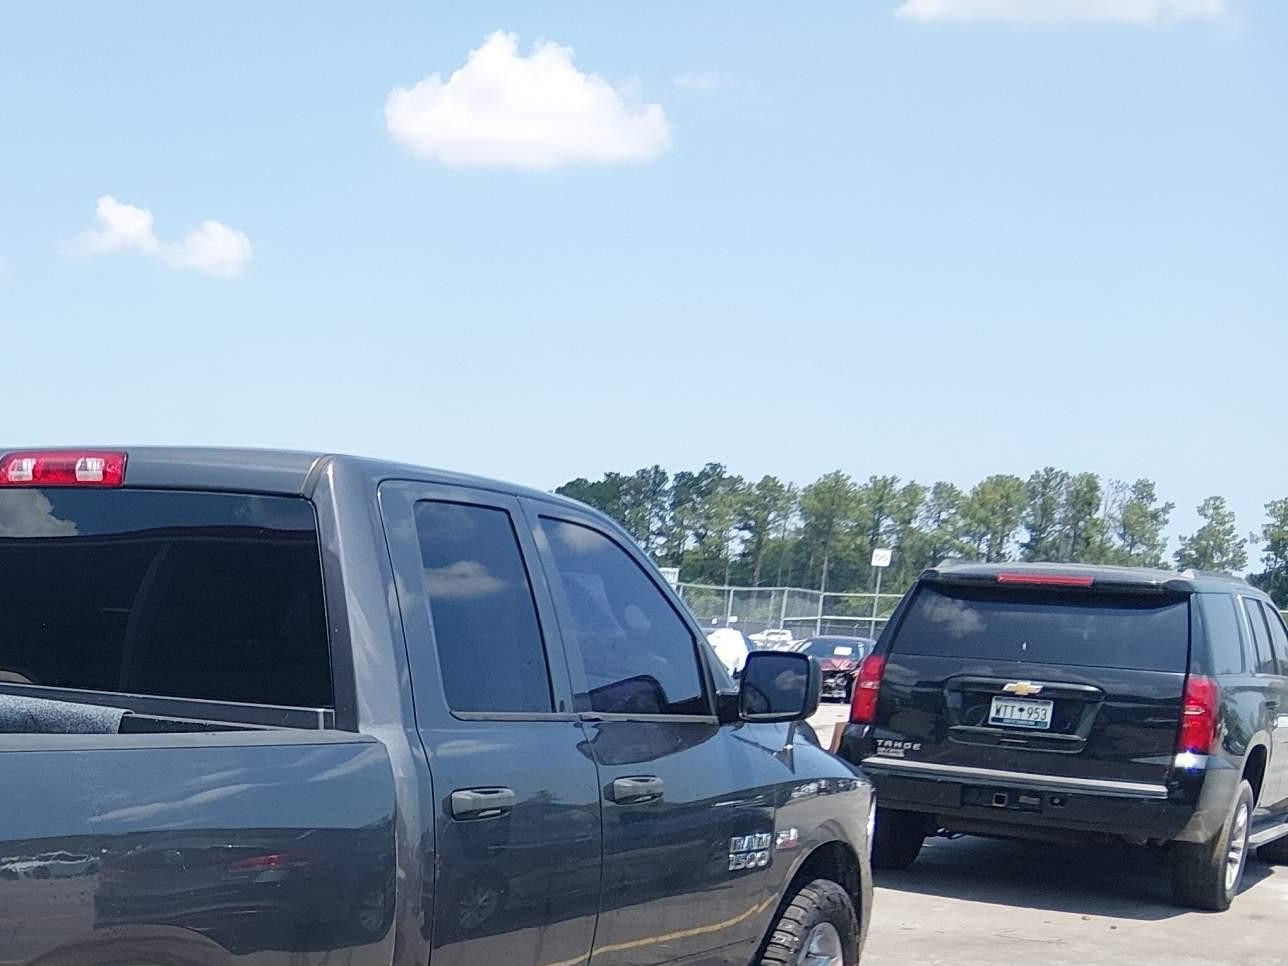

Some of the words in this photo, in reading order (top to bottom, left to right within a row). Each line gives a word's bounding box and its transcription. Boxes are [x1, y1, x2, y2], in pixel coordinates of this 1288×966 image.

[1026, 706, 1048, 721] 953
[876, 739, 922, 751] TAHOE
[729, 832, 772, 853] RAM
[728, 850, 770, 871] 1500
